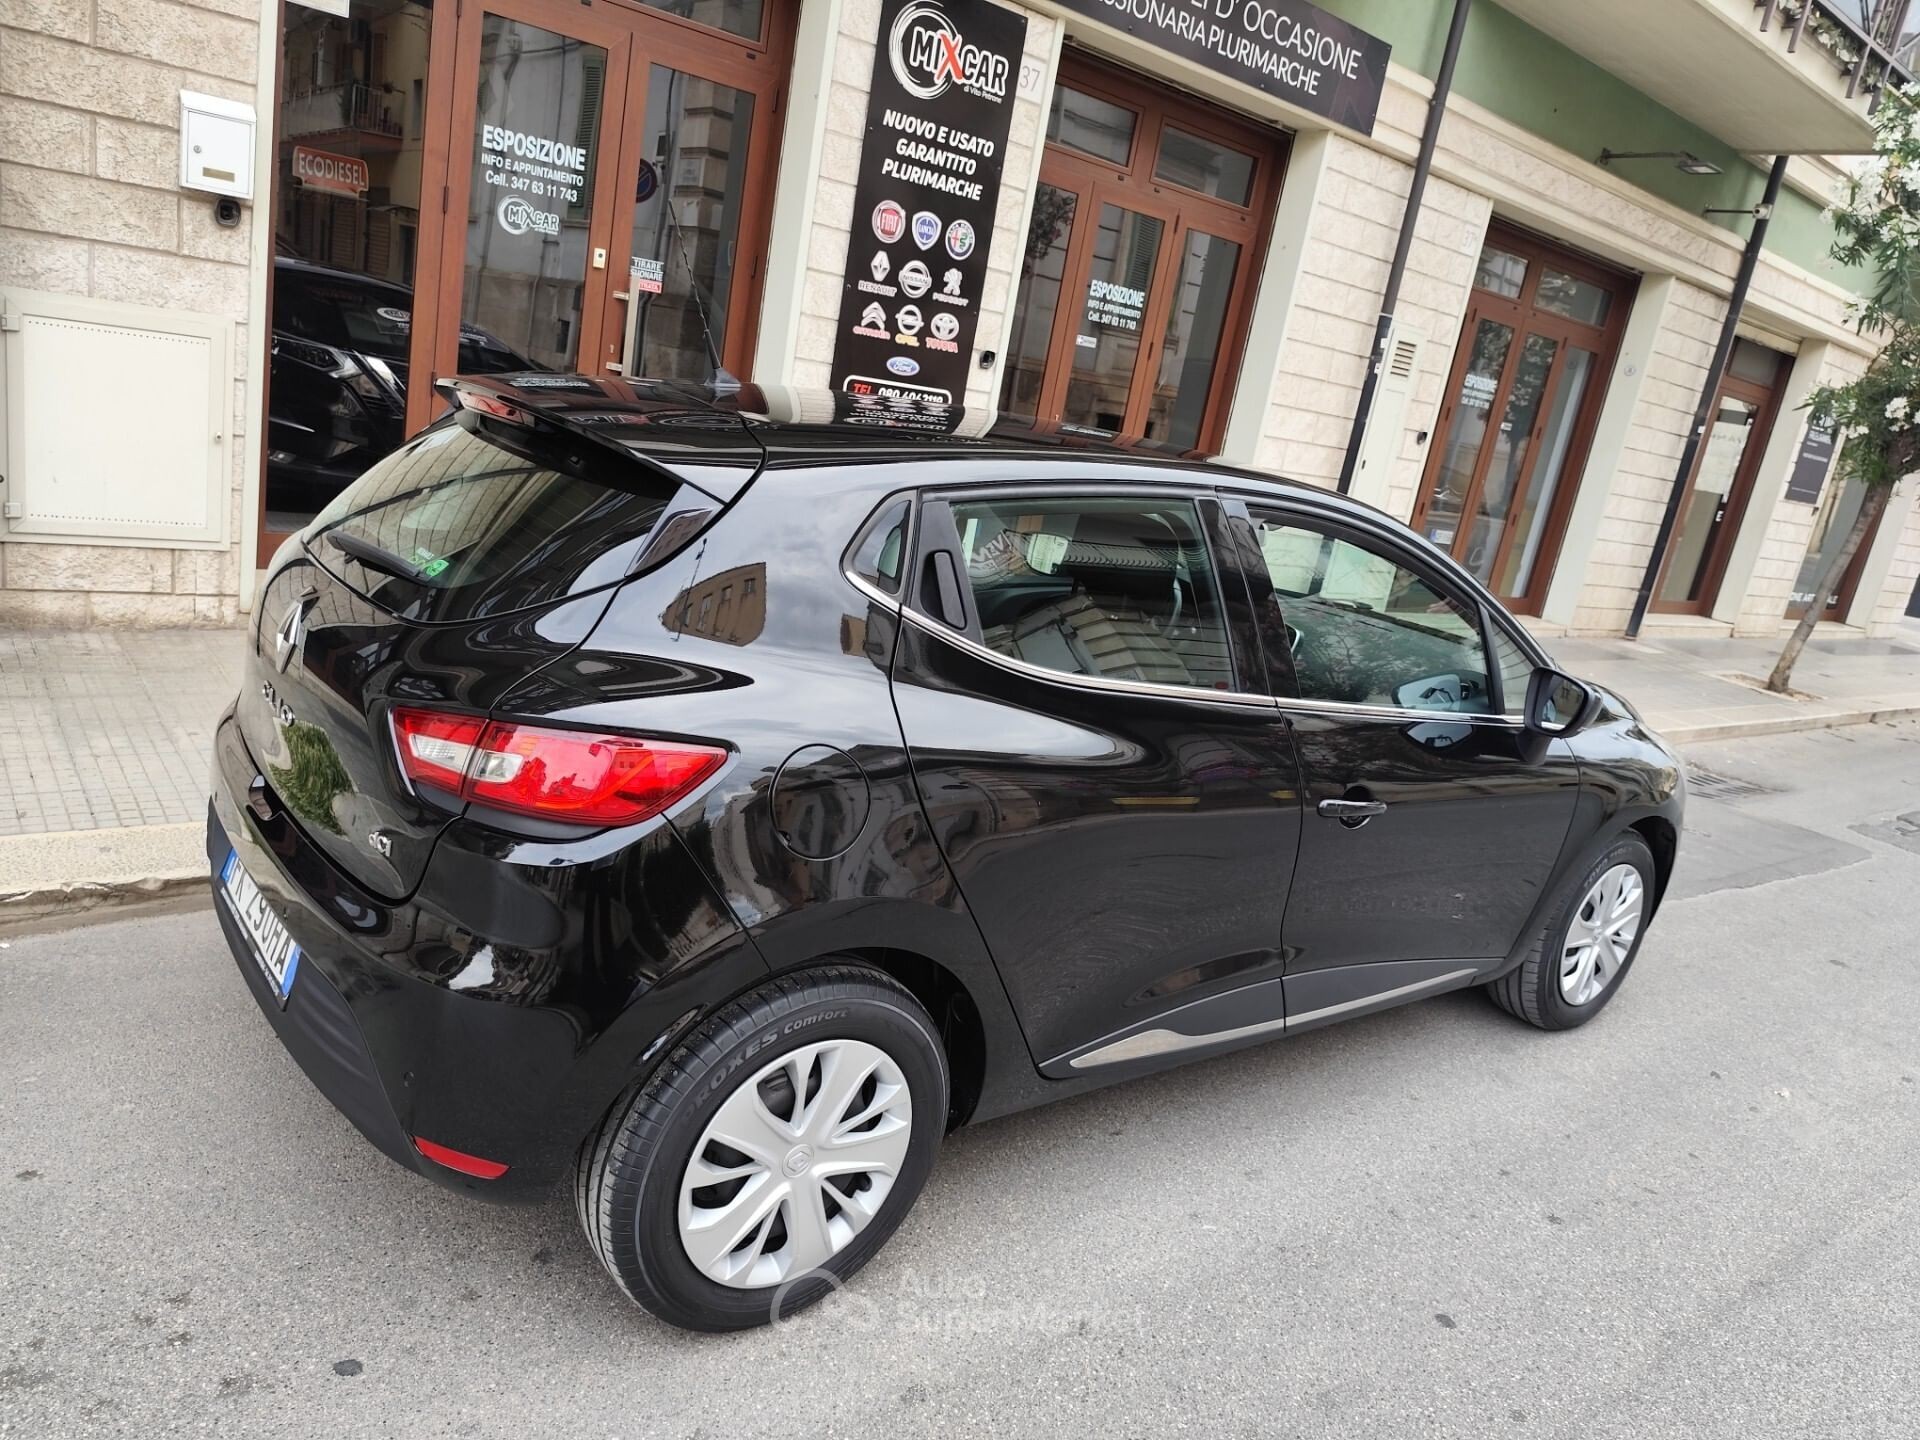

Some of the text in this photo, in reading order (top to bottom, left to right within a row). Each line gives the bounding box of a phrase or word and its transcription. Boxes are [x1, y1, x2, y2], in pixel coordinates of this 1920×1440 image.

[1243, 1, 1362, 80] OCCASIONE
[909, 25, 1009, 96] MIXCAR
[1207, 25, 1321, 96] PLURIMARCHE
[1019, 65, 1041, 92] 37
[482, 124, 587, 171] ESPOSIZIONE
[883, 109, 995, 157] NUOVO E USATO
[298, 152, 365, 186] ECODIESEL
[481, 152, 584, 187] INFO E APPUNTAMENTO
[896, 138, 977, 175] GARANTITO
[485, 170, 578, 202] Cell. 347 63 11 743
[881, 158, 983, 200] PLURIMARCHE
[881, 212, 899, 232] FIAT
[858, 280, 897, 298] RENAULT
[1089, 279, 1146, 308] ESPOSIZIONE
[783, 1009, 849, 1035] comfort
